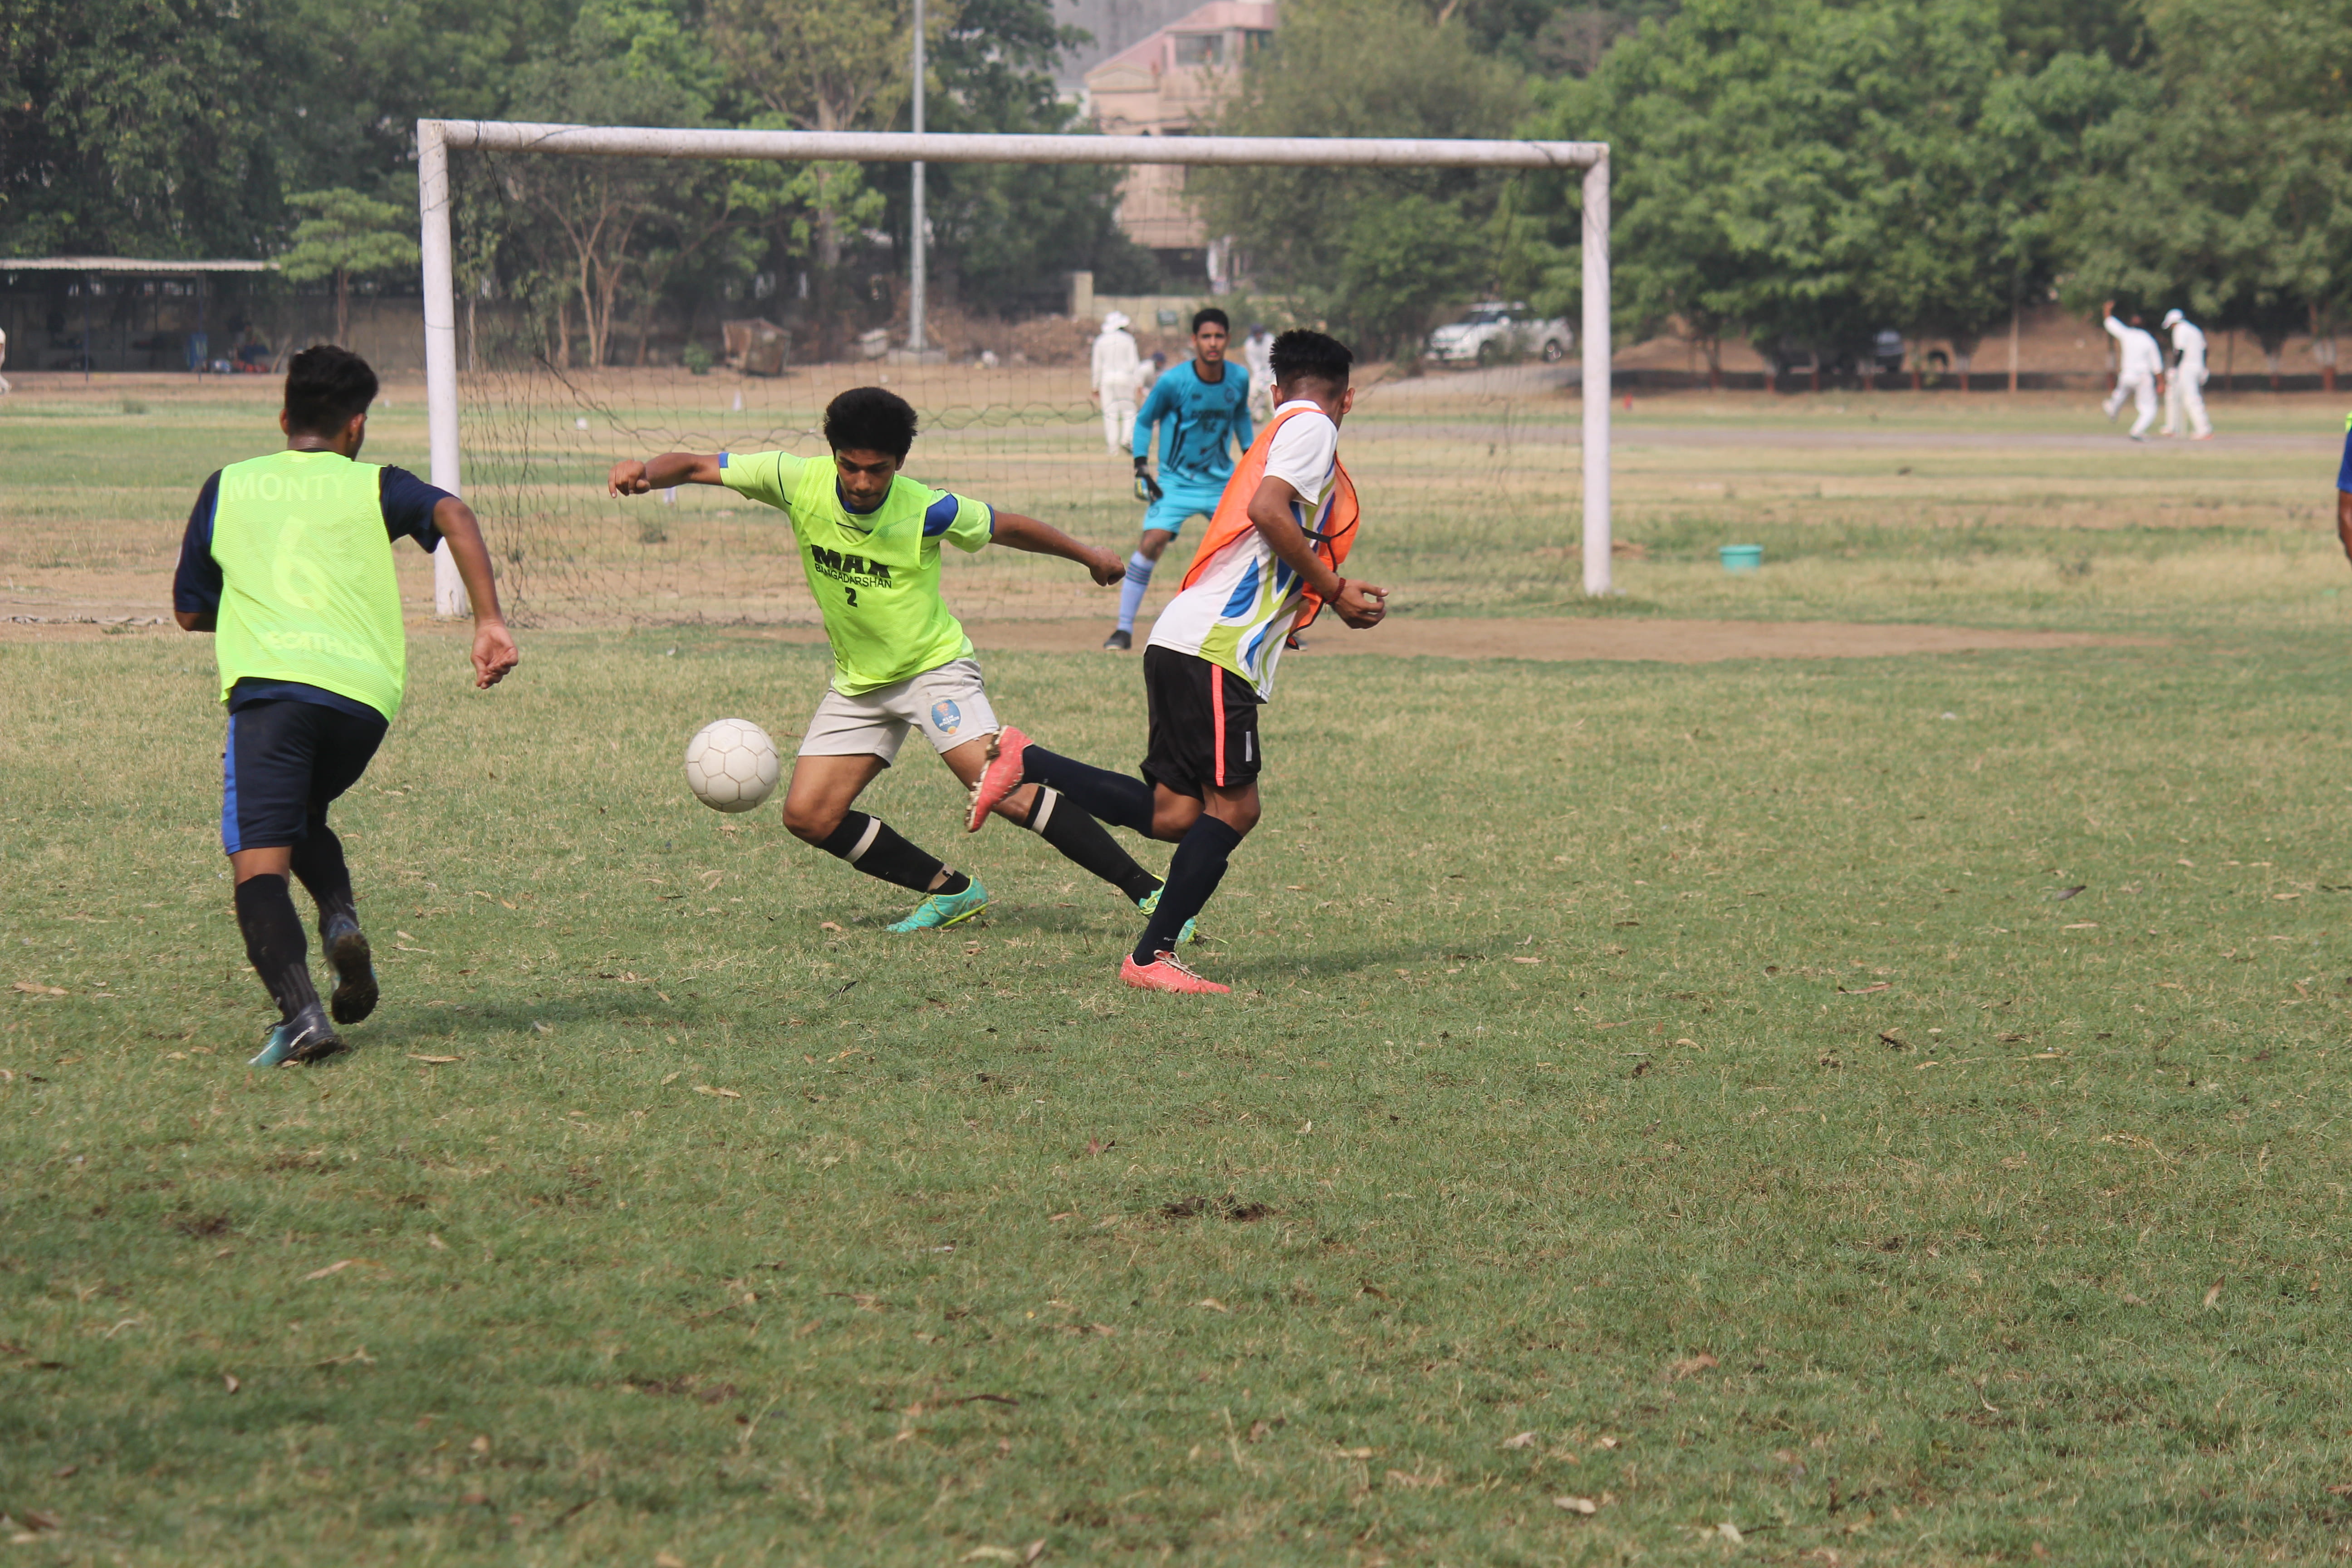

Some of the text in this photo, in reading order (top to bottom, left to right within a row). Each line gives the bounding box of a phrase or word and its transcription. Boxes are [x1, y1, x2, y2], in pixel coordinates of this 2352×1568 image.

[227, 472, 349, 503] MONTY
[271, 514, 328, 611] 6
[810, 544, 892, 579] MAX
[844, 587, 858, 608] 2
